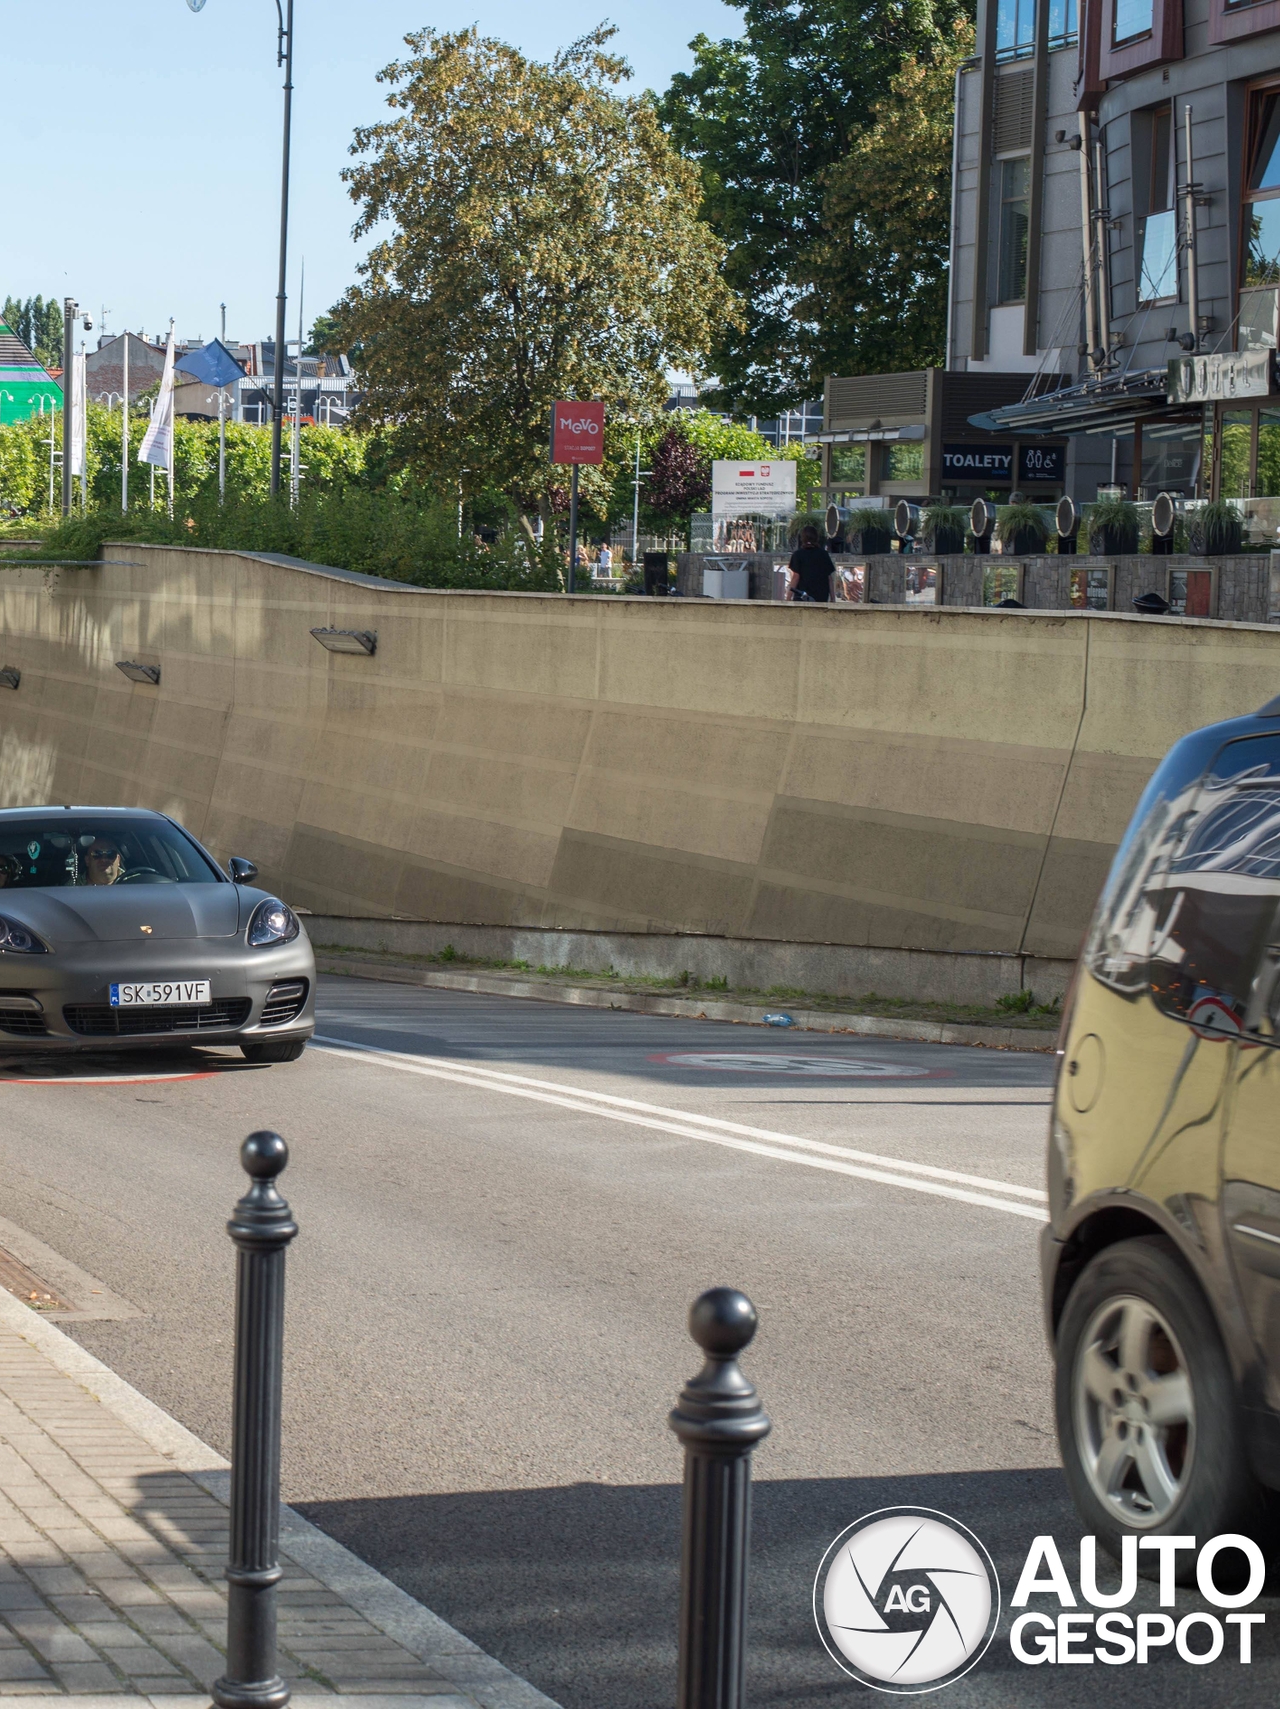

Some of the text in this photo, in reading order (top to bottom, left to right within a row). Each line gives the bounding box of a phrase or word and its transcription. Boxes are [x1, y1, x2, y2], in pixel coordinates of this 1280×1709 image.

[943, 454, 1011, 468] TOALETY
[122, 983, 205, 1003] SK 591VF
